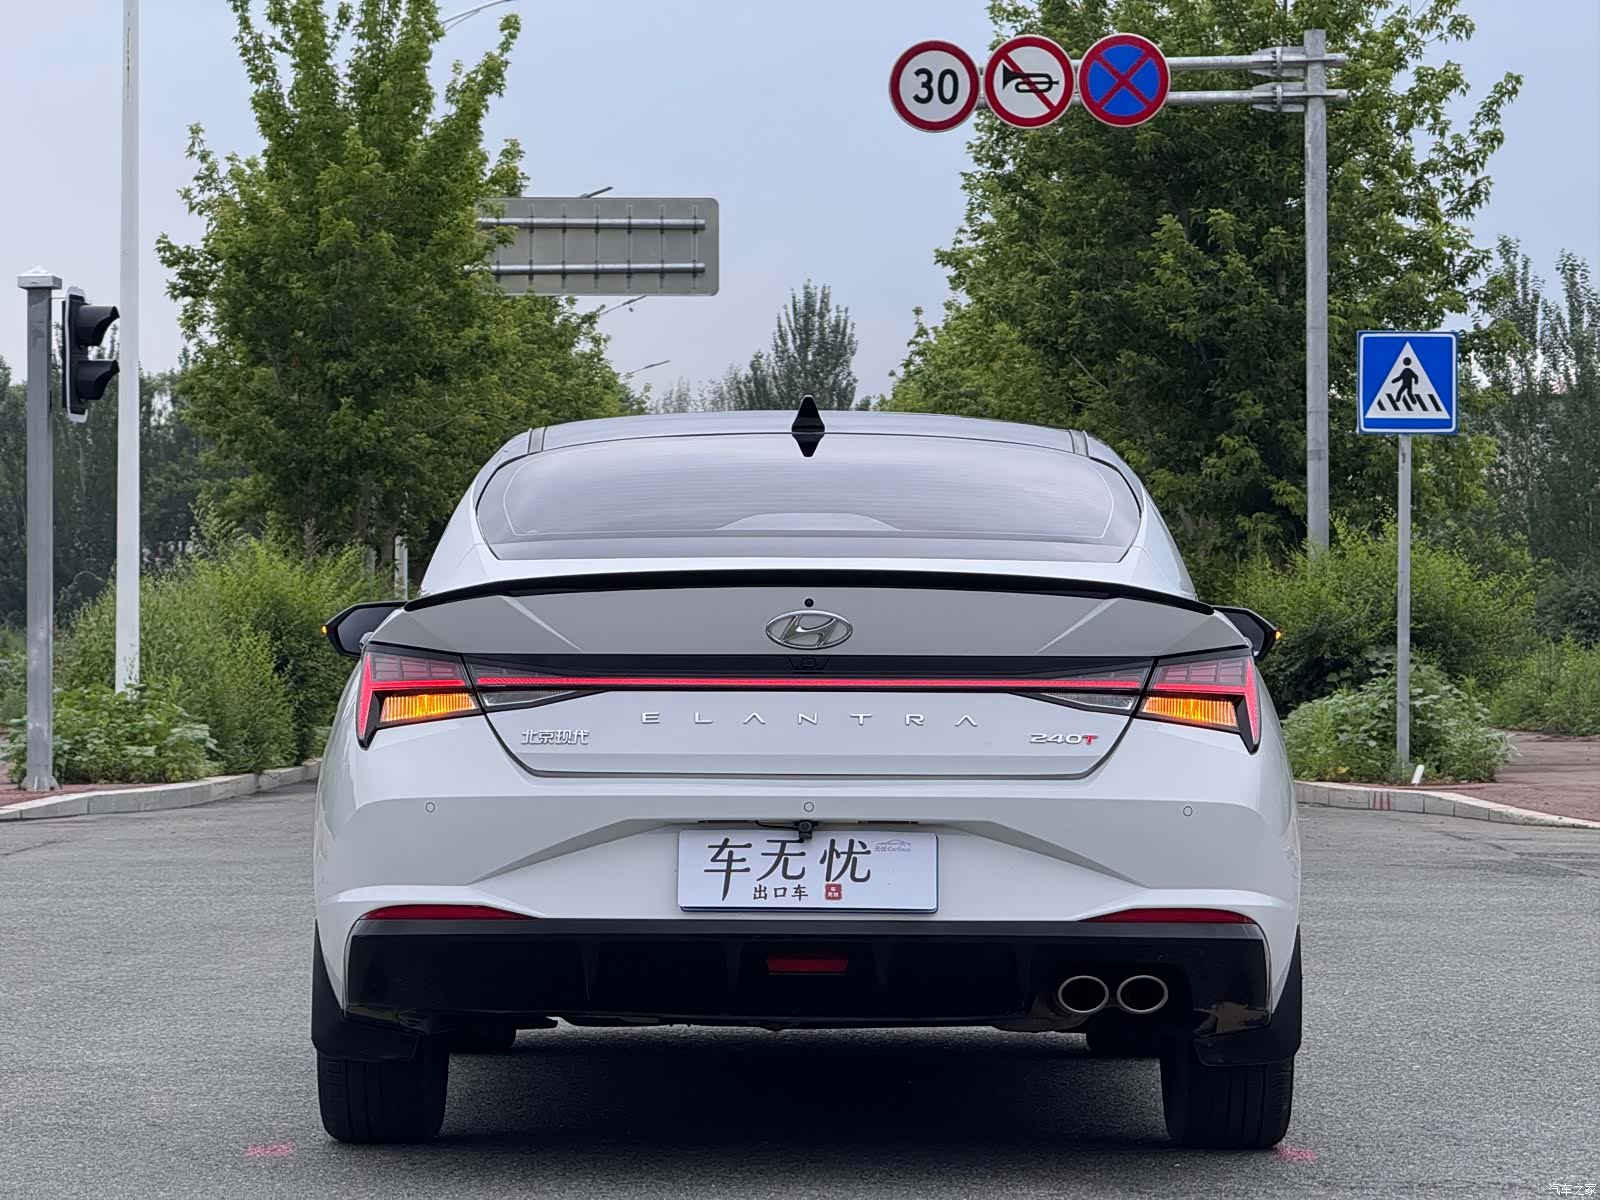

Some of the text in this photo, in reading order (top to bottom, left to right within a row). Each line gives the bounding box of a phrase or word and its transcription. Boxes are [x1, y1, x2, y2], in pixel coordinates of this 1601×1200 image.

[913, 67, 959, 105] 30
[641, 712, 979, 727] ELANTRA
[521, 729, 590, 745] 北京现代
[1030, 733, 1099, 745] 240T
[703, 837, 872, 901] 车无忧
[753, 884, 809, 902] 出口车
